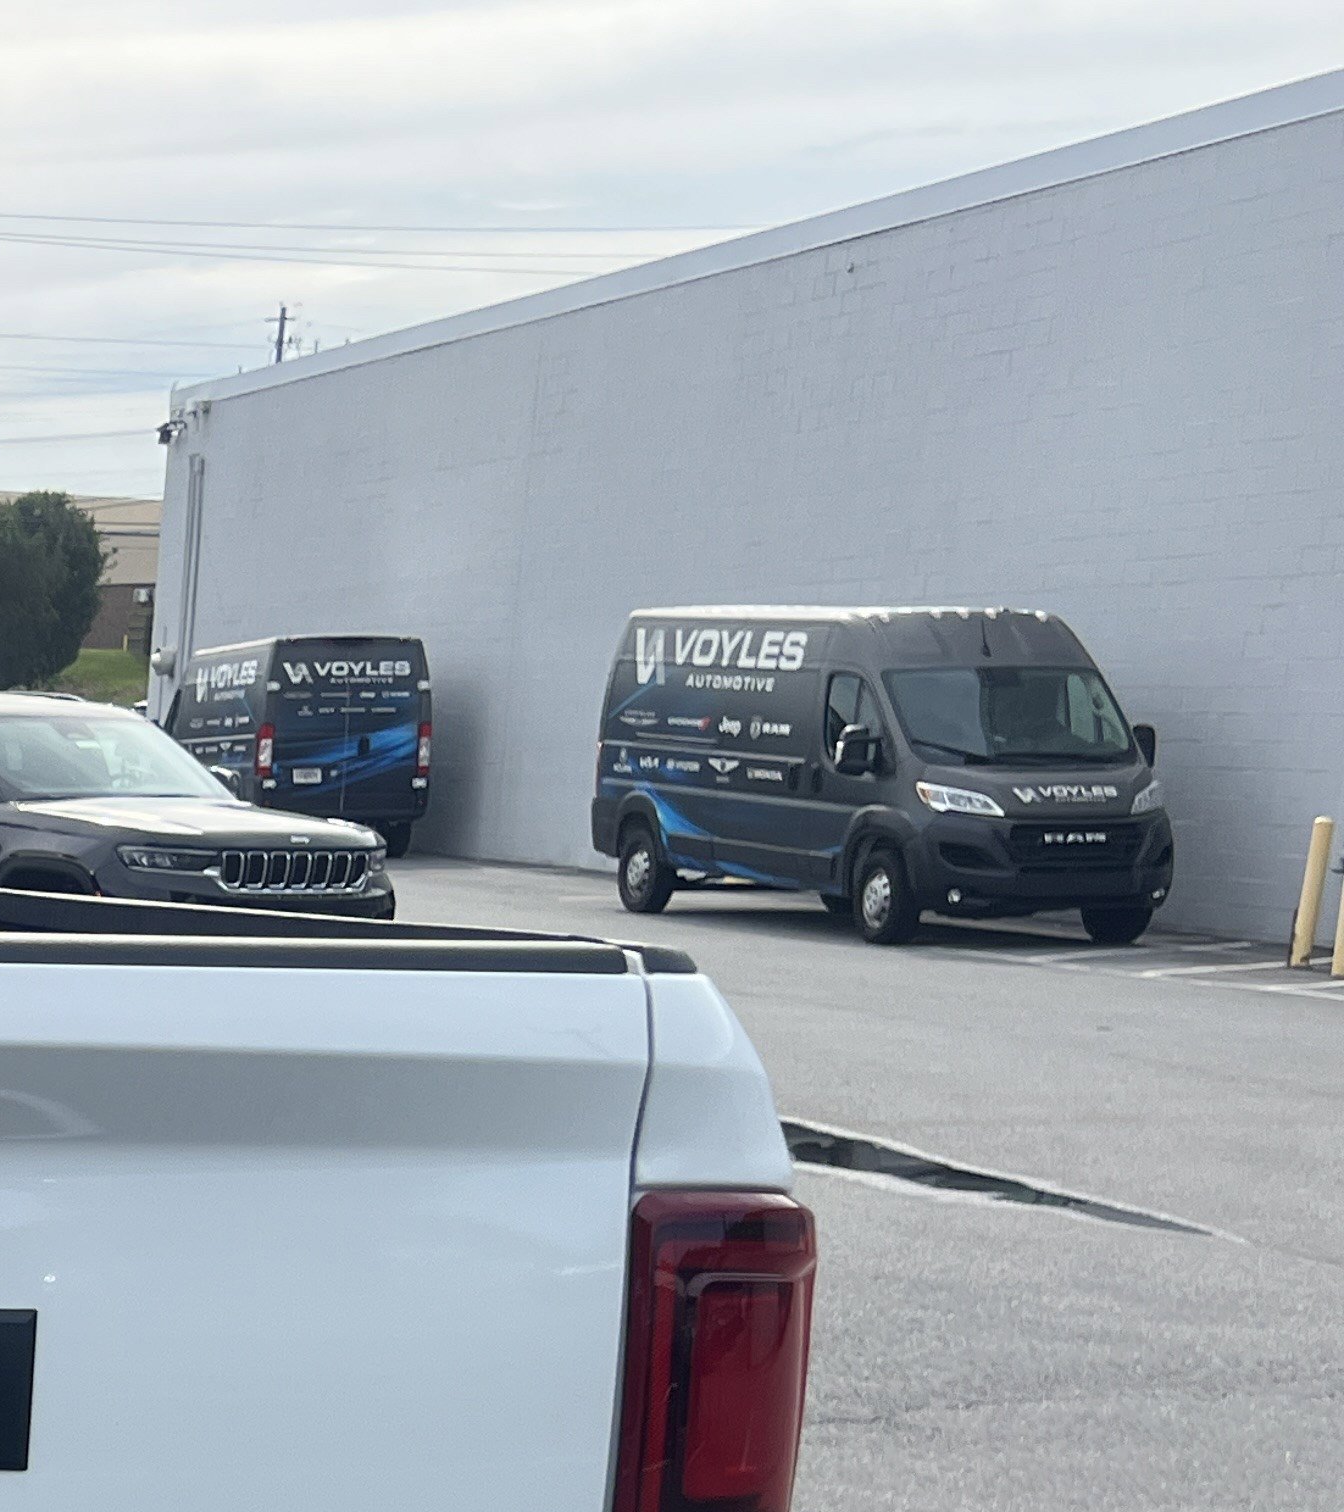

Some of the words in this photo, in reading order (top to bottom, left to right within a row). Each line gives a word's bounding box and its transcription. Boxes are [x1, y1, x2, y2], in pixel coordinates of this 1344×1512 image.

[675, 628, 808, 672] VOYLES
[313, 660, 411, 676] VOYLES
[685, 673, 776, 693] AUTOMOTIVE
[1038, 785, 1117, 797] VOYLES
[1044, 832, 1107, 843] RAM
